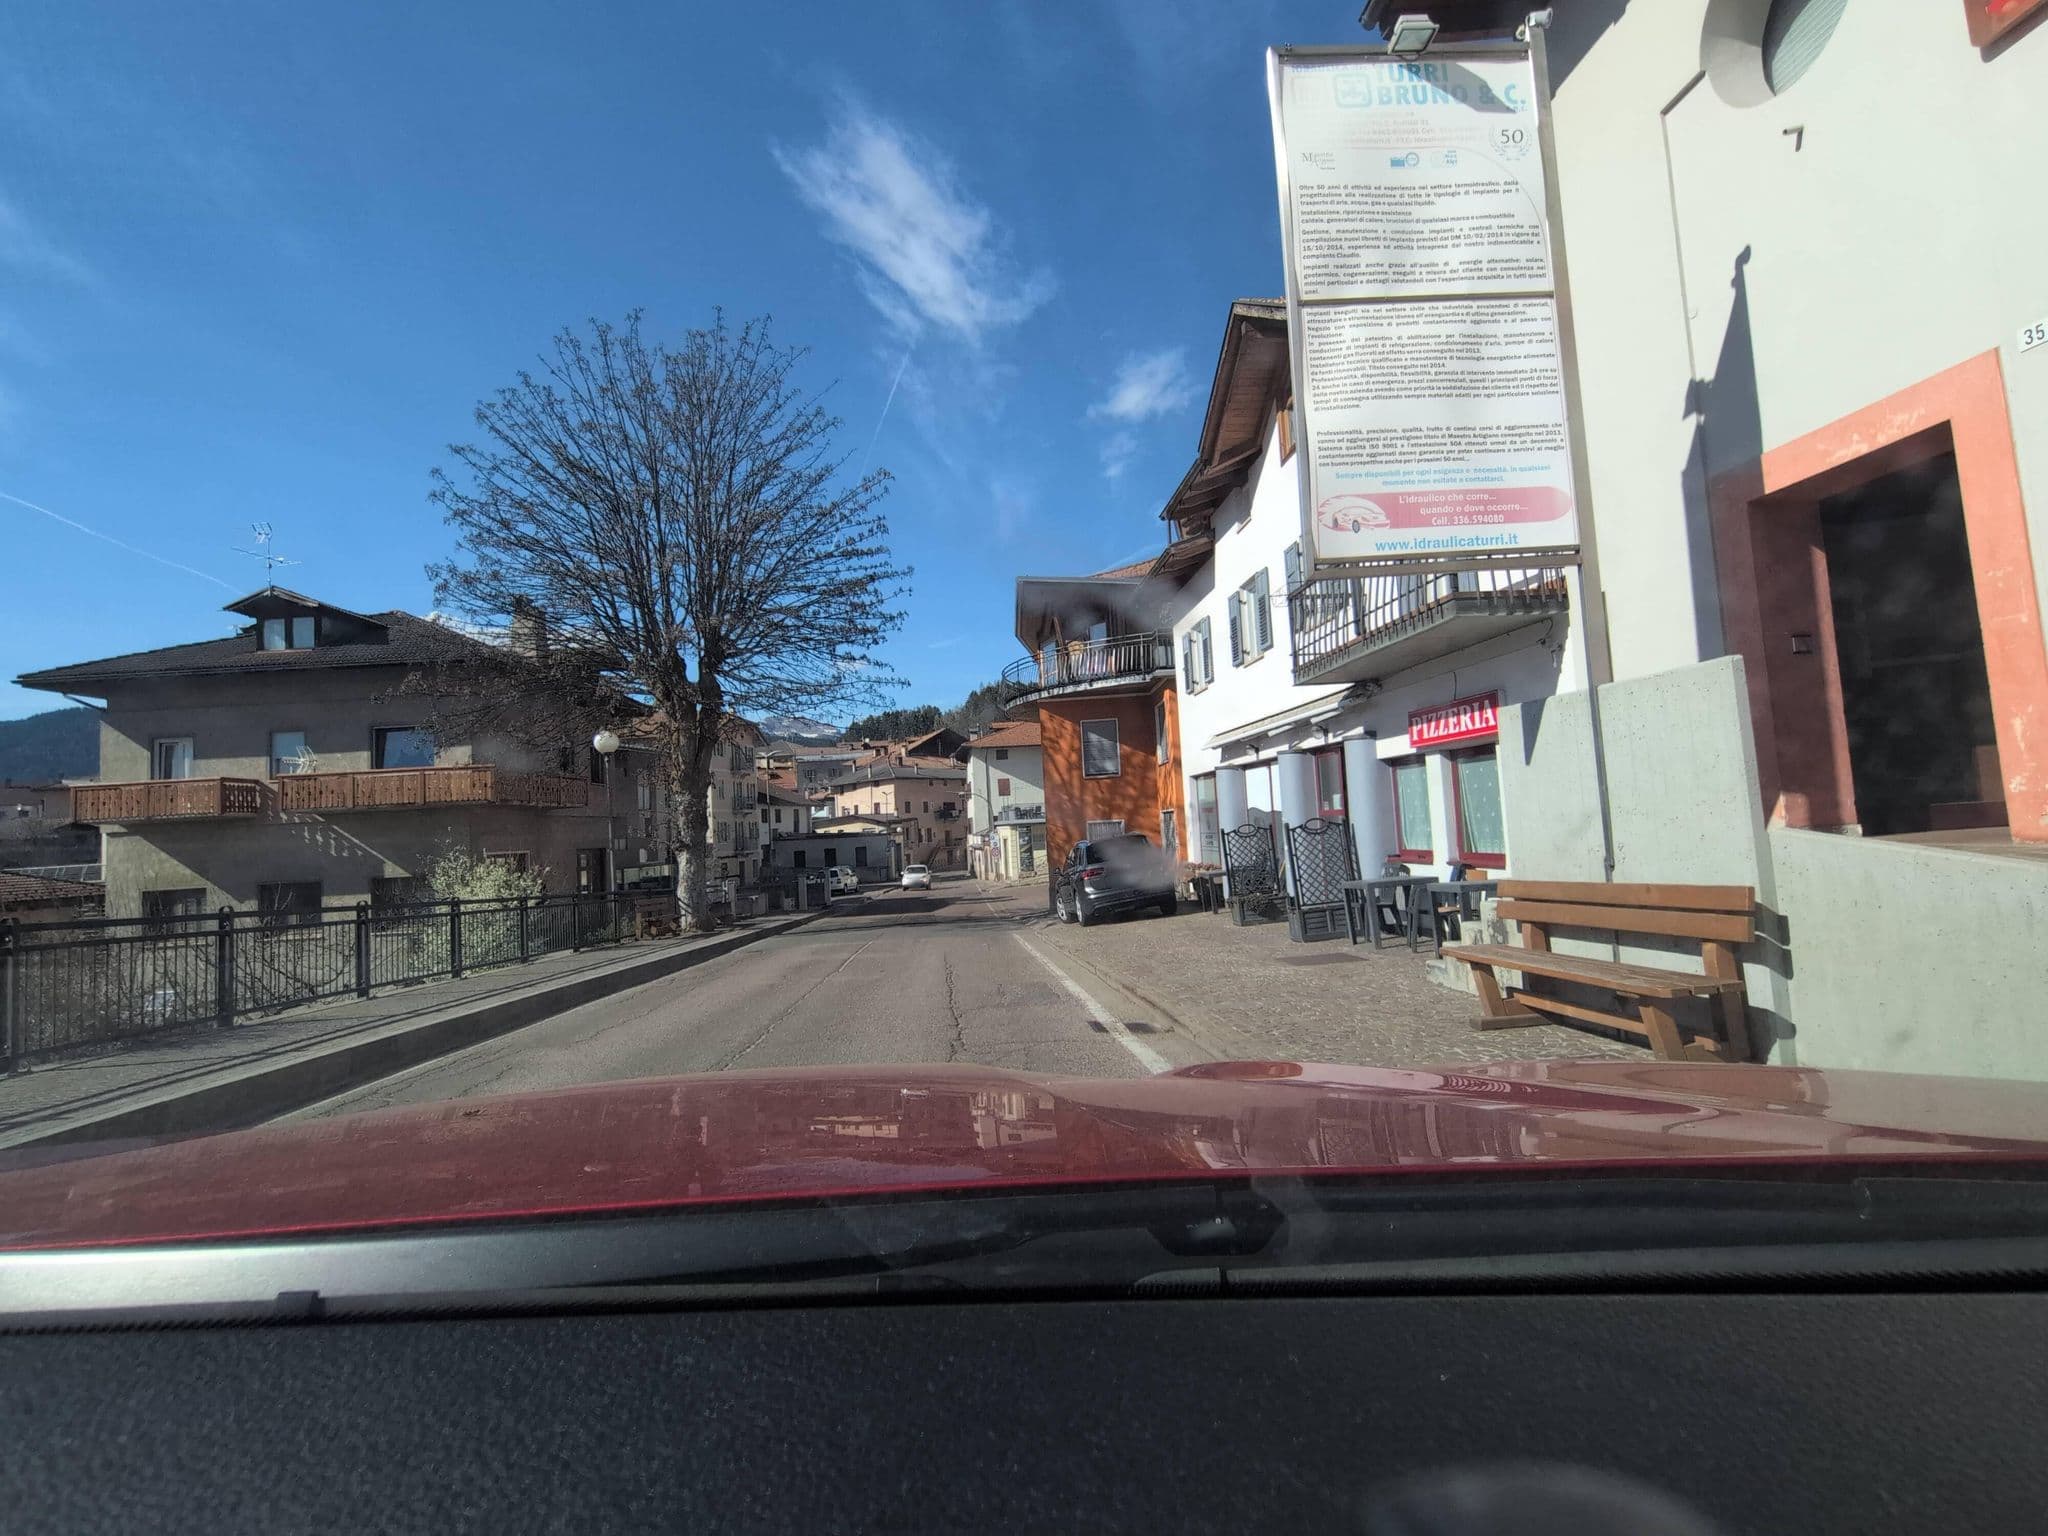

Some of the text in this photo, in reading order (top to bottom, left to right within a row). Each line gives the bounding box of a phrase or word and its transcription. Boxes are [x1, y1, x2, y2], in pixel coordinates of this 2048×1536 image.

[1376, 63, 1449, 82] TURRI
[1376, 81, 1527, 105] BRUNO & C.
[1500, 128, 1524, 145] 50
[2023, 322, 2045, 346] 35
[1399, 494, 1446, 504] L'idraulico
[1448, 494, 1464, 502] che
[1420, 505, 1454, 515] quando
[1464, 504, 1485, 512] dove
[1453, 514, 1505, 525] 336.594080
[1375, 533, 1519, 552] www.idraulicaturri.it
[1410, 699, 1496, 741] PIZZERIA
